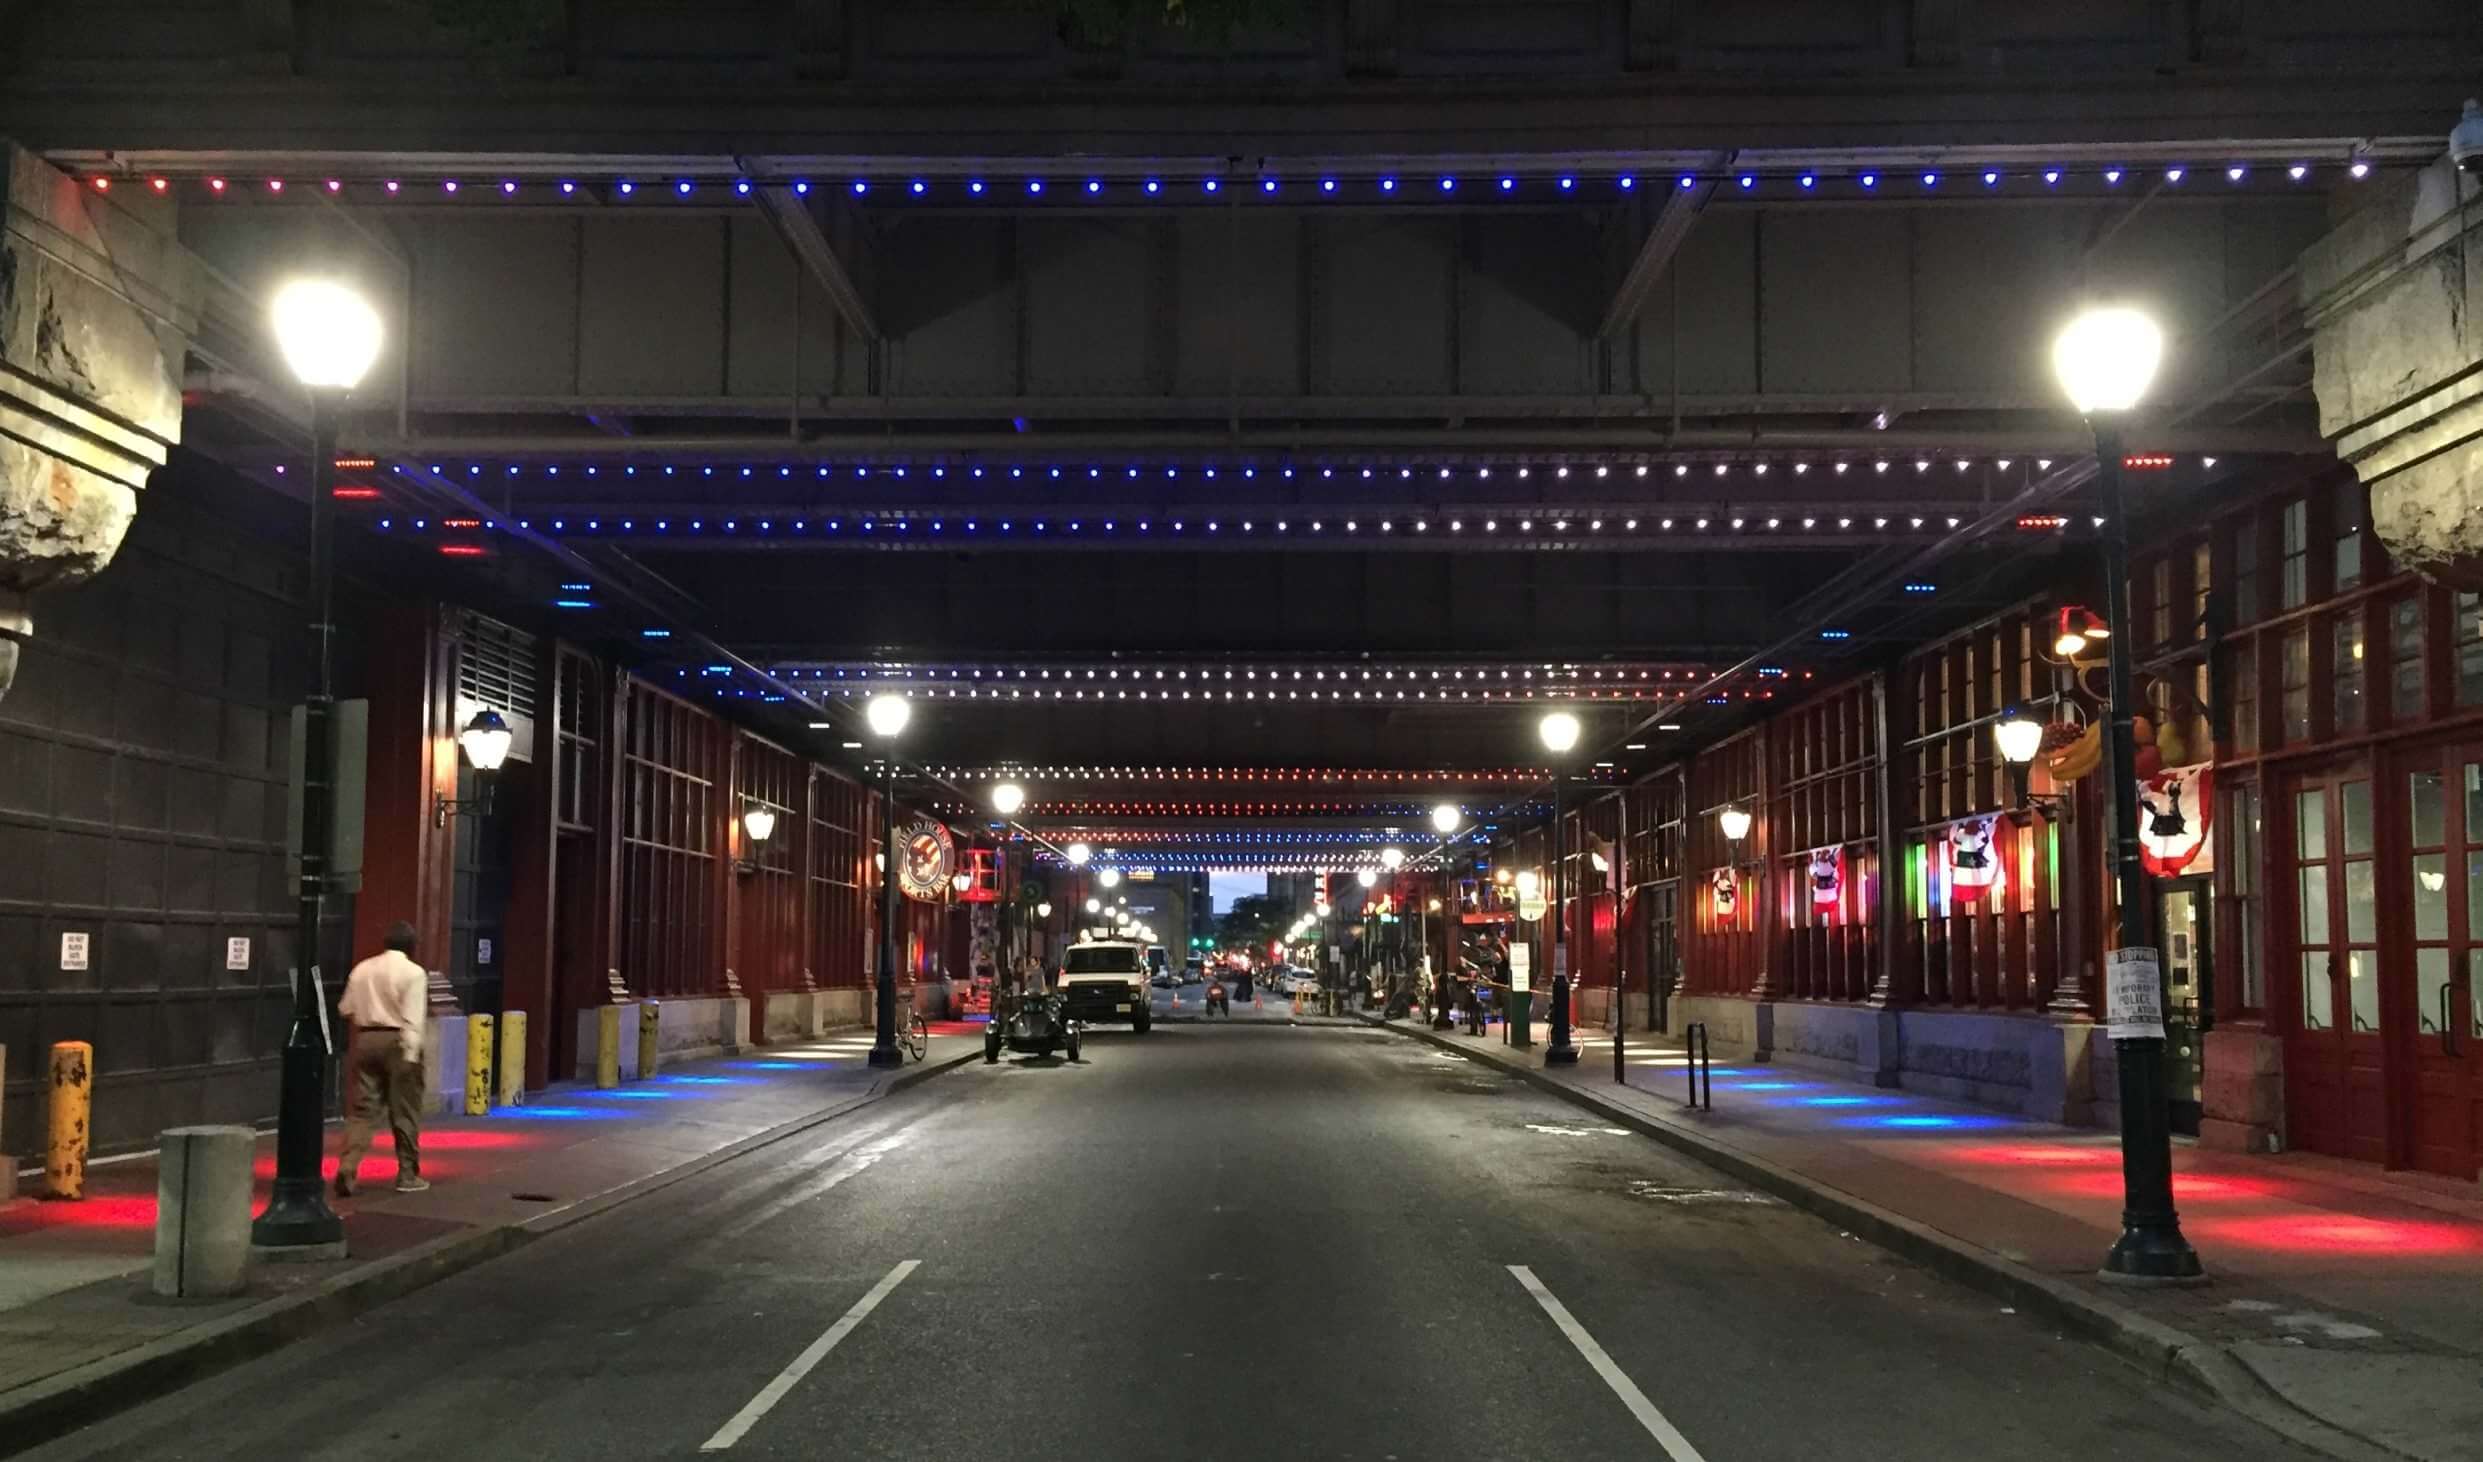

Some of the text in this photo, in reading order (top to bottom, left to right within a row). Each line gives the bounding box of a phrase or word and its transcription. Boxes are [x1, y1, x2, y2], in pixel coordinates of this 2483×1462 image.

[898, 821, 952, 850] FIELD HOUSE
[2119, 994, 2152, 1005] POLICE
